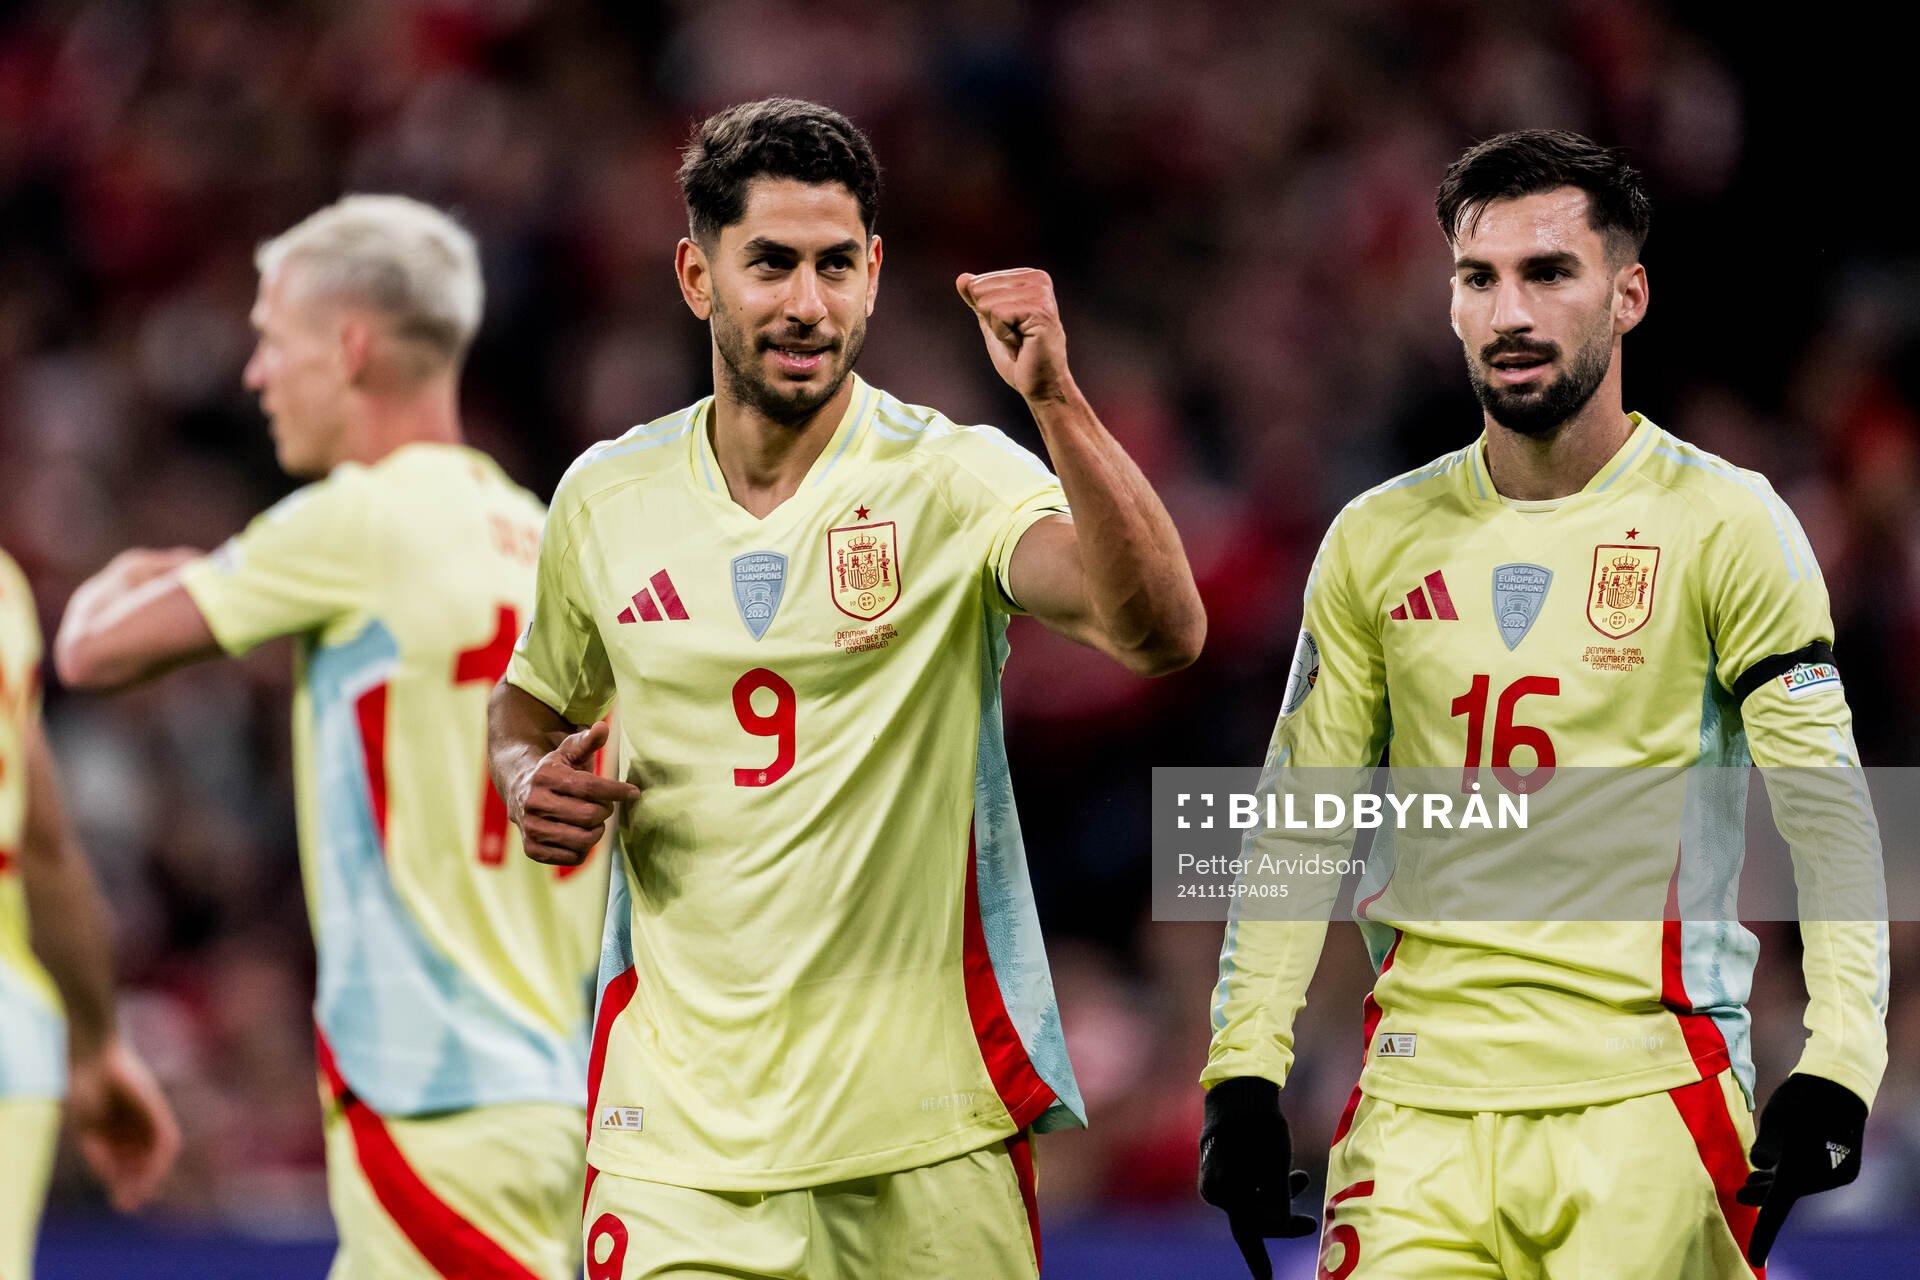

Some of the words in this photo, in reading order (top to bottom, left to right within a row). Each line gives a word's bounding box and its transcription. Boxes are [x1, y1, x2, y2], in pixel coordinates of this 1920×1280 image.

[751, 555, 769, 563] UEFA
[736, 563, 782, 573] EUROPEAN
[1514, 567, 1533, 575] UEFA
[736, 571, 782, 581] CHAMPIONS
[1498, 574, 1545, 585] EUROPEAN
[1497, 582, 1544, 593] CHAMPIONS
[746, 609, 769, 619] 2024
[1503, 619, 1526, 628] 2024
[837, 630, 868, 640] DENMARK
[874, 623, 894, 634] SPAIN
[843, 634, 879, 647] NOVEMBER
[880, 630, 898, 641] 2024
[845, 640, 889, 655] COPENHAGEN
[1585, 646, 1616, 655] DENMARK
[1622, 647, 1642, 656] SPAIN
[1590, 654, 1626, 663] NOVEMBER
[1627, 656, 1645, 665] 2024
[1591, 662, 1633, 672] COPENHAGEN
[732, 667, 797, 788] 9
[1451, 674, 1560, 796] 16
